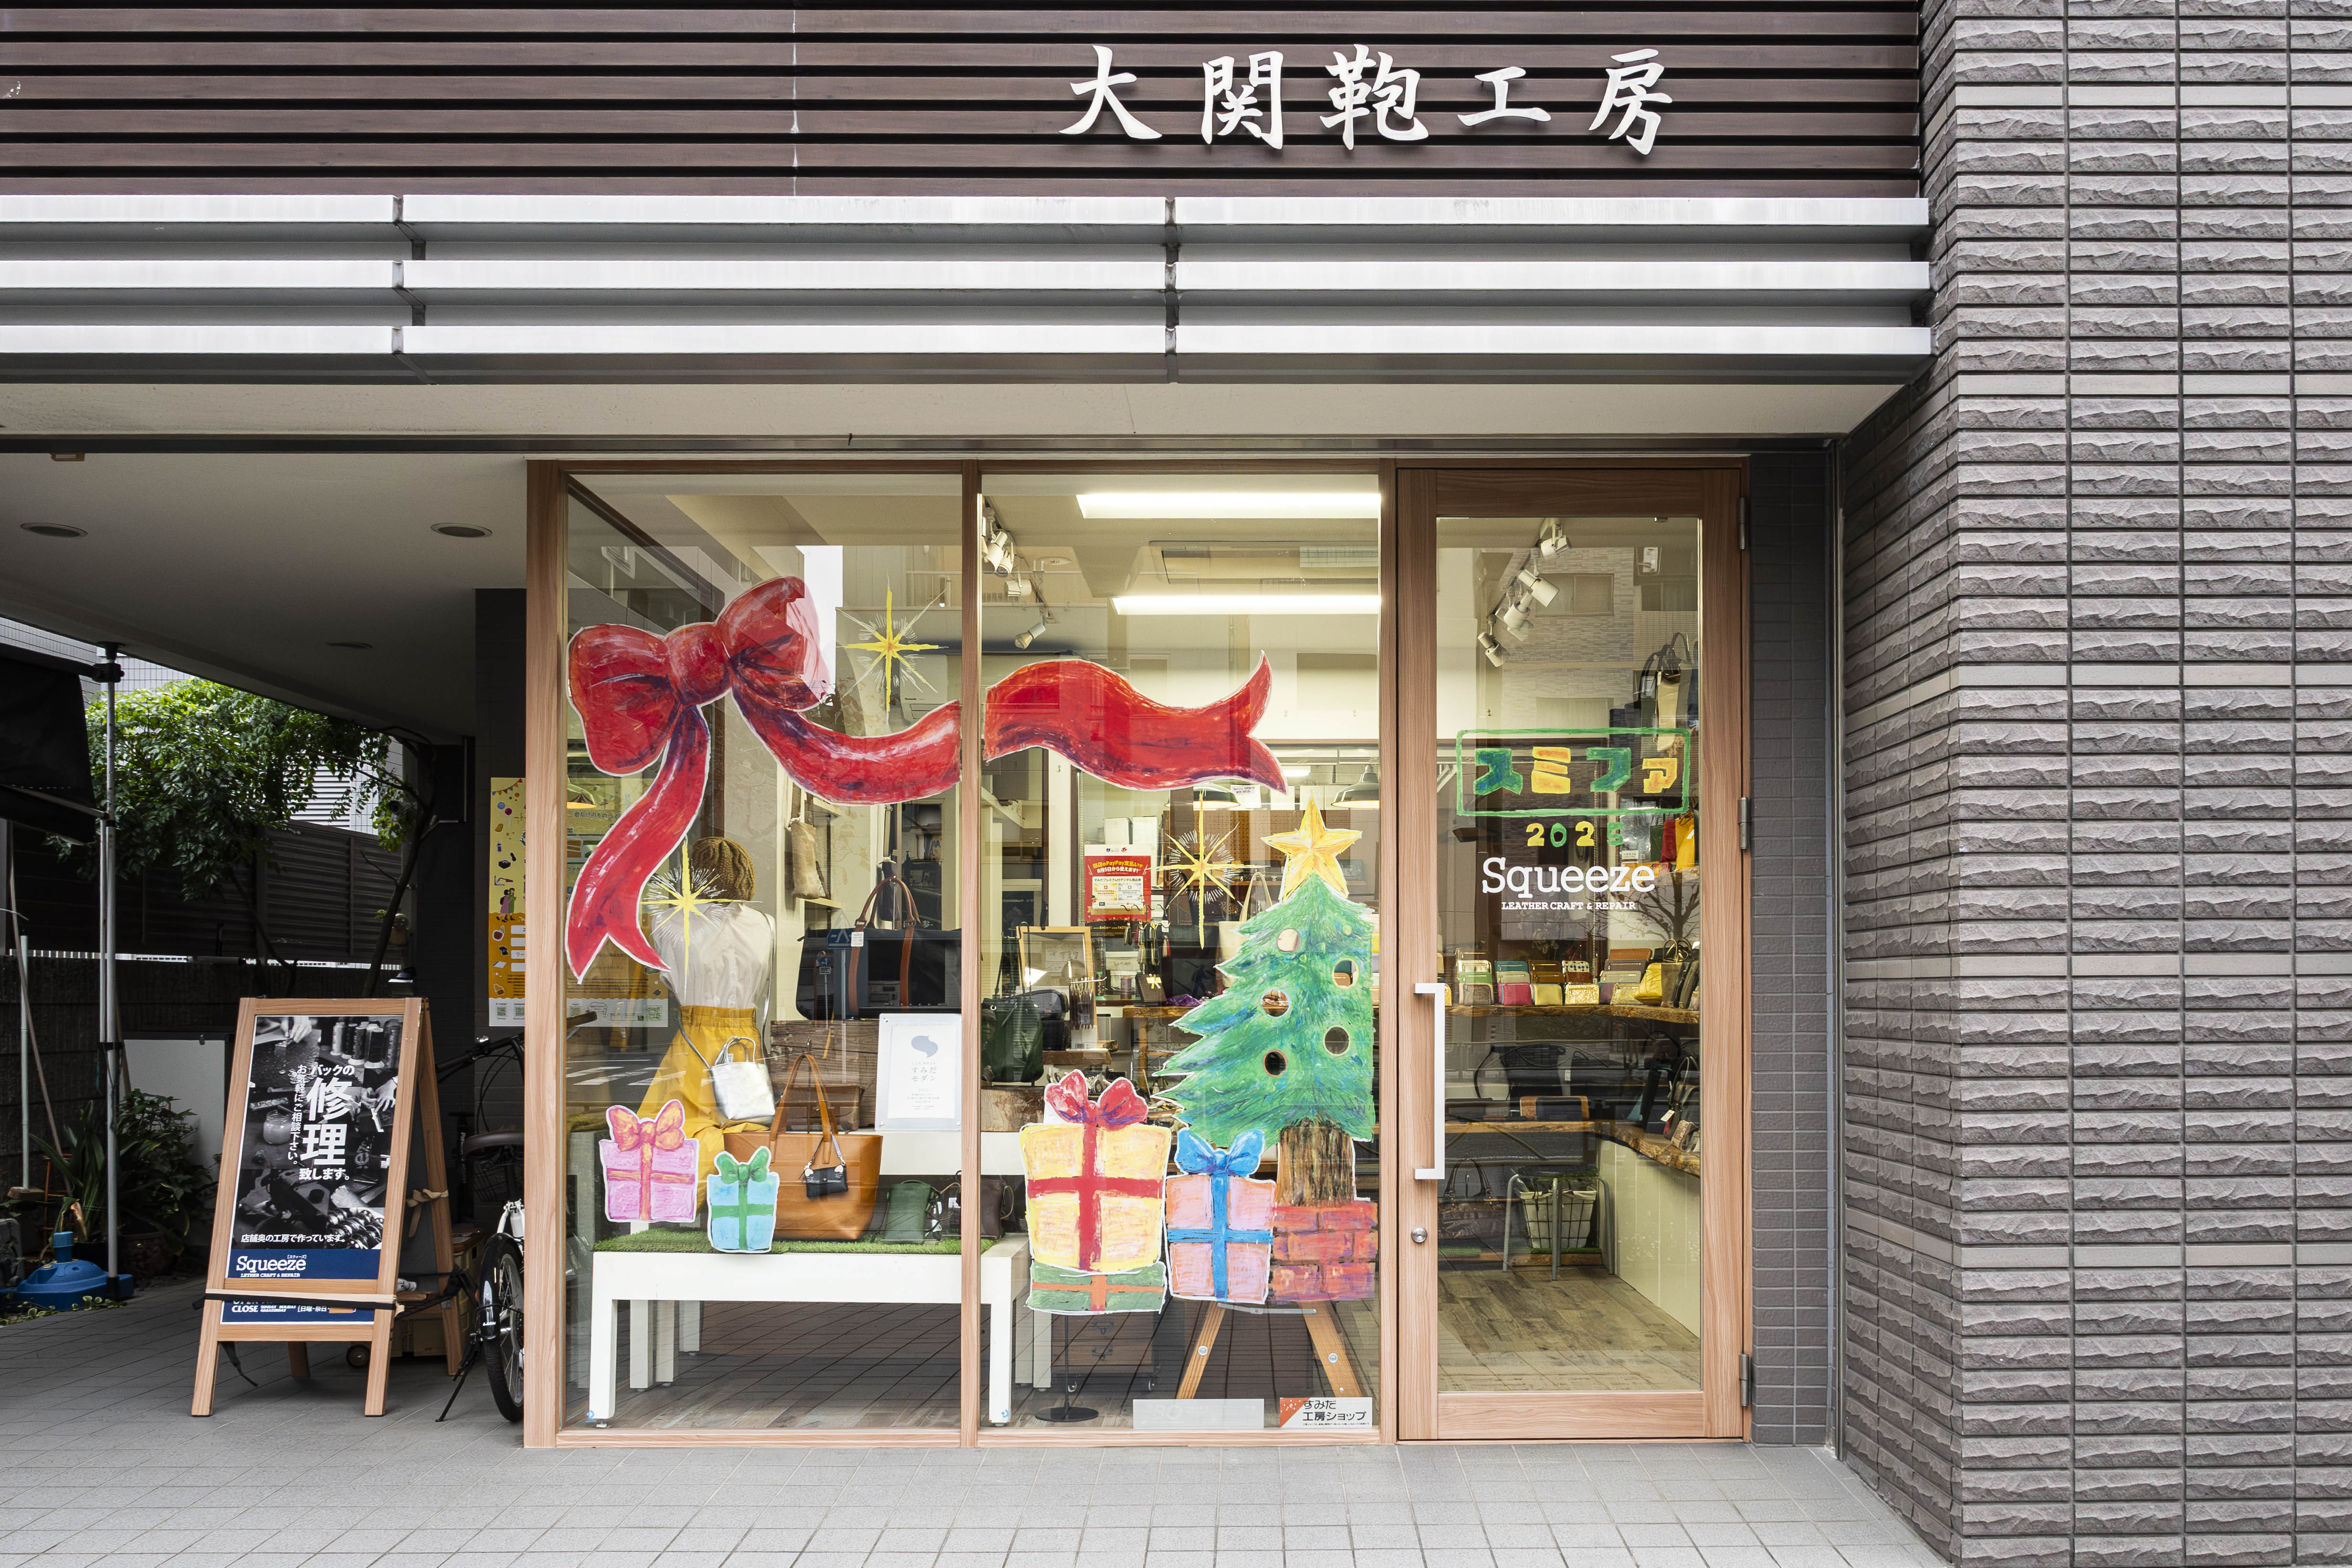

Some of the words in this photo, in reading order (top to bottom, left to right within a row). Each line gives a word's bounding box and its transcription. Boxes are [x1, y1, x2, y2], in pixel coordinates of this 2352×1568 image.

[1059, 43, 1672, 155] 大関鞄工房
[1473, 746, 1677, 796] スミファ
[1526, 821, 1624, 847] 2025
[1482, 857, 1655, 898] Squeeze
[1502, 902, 1549, 910] LEATHER
[1550, 902, 1584, 910] CRAFT
[1596, 902, 1636, 910] REPAIR
[311, 1064, 355, 1076] バックの
[288, 1064, 307, 1165] お気軽にご相談下さい。
[300, 1077, 353, 1165] 修理
[299, 1168, 349, 1180] 致します。
[241, 1234, 345, 1242] 店舗奥の工房で作っています。
[236, 1256, 306, 1273] Squeeze
[1303, 1400, 1336, 1410] すみだ
[1303, 1411, 1366, 1421] 工房ショップ
